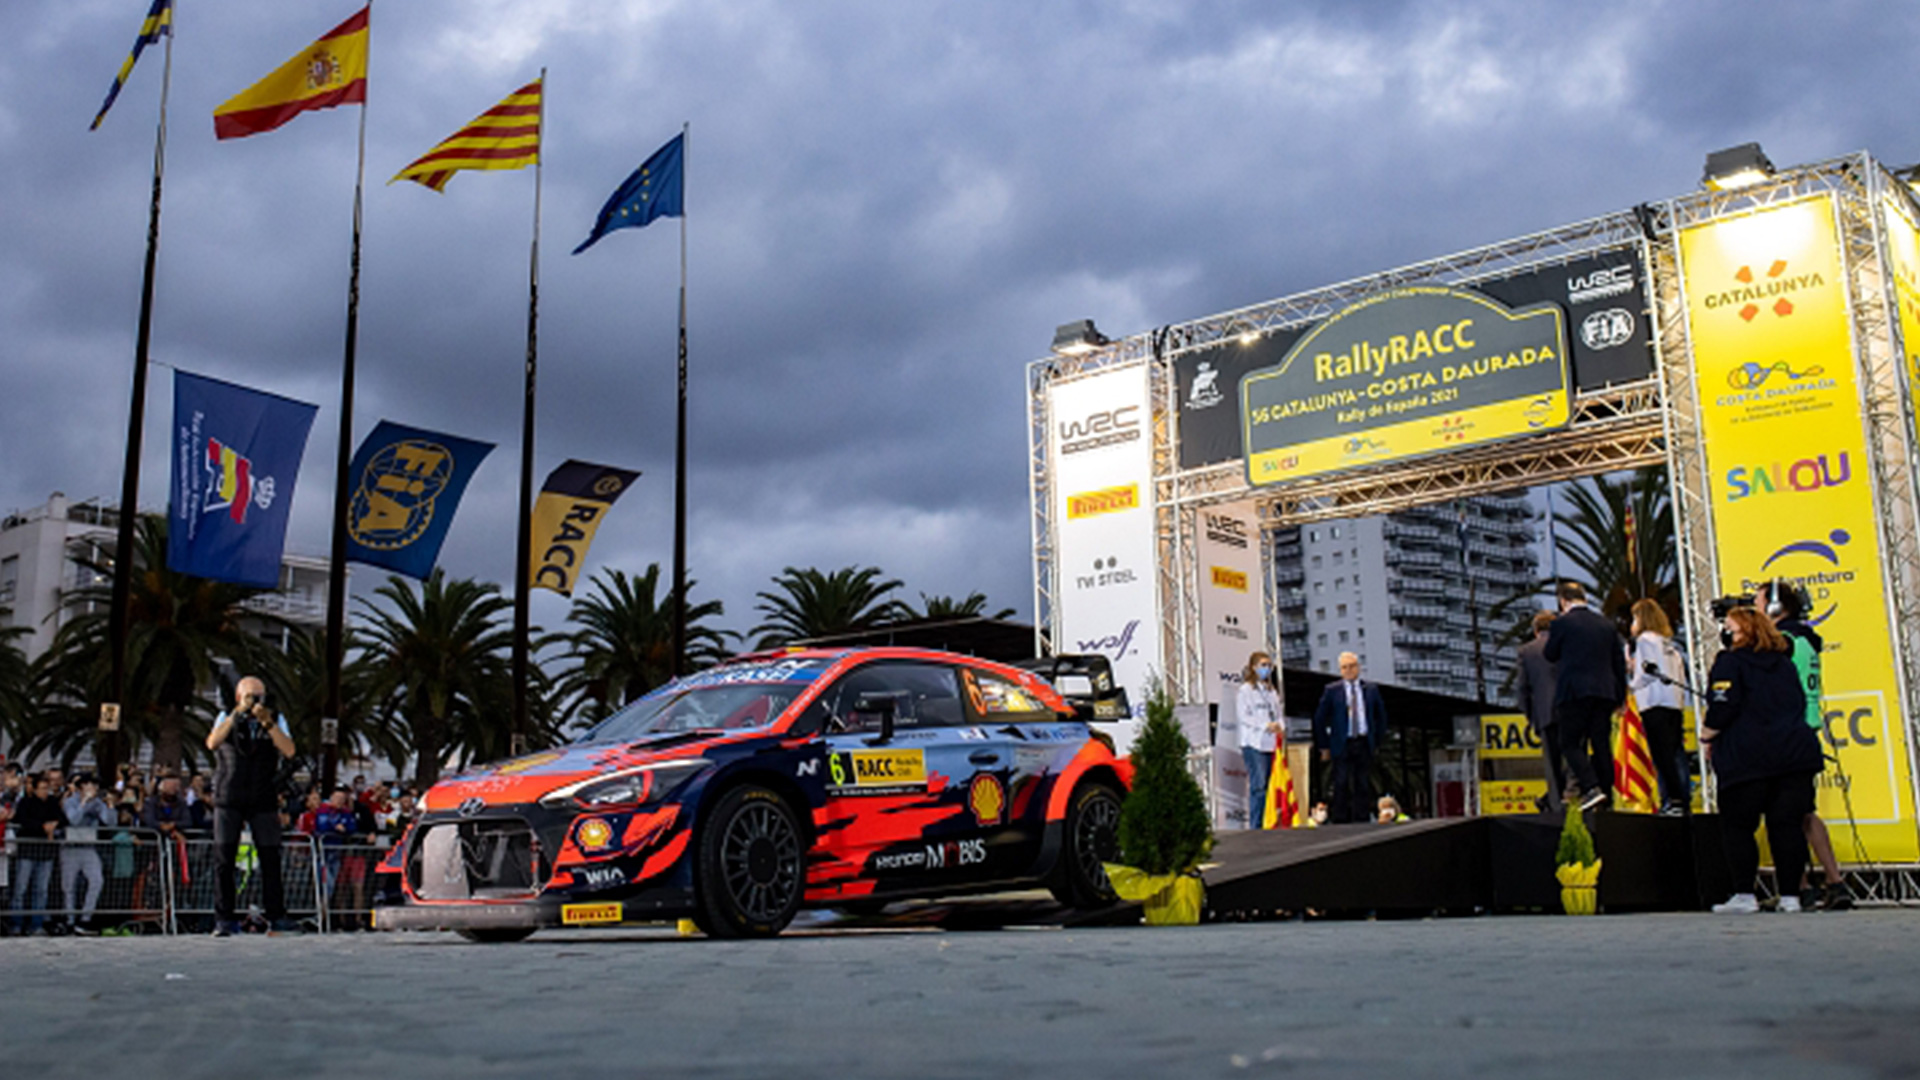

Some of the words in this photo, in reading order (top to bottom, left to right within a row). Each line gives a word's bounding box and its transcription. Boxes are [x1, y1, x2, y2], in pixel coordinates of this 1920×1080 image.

[1704, 273, 1826, 309] CATALUNYA
[1313, 320, 1475, 382] RallyRACC
[1251, 408, 1269, 426] 56
[1442, 345, 1556, 384] DAURADA
[1060, 405, 1140, 440] WRC
[1337, 407, 1366, 423] Rally
[1372, 403, 1384, 416] de
[1431, 387, 1459, 404] 2021
[358, 442, 448, 531] FIA
[1726, 451, 1852, 501] SALOU
[536, 503, 602, 593] RACC
[1484, 720, 1543, 751] RAC
[1823, 708, 1877, 748] CC
[829, 752, 847, 787] 6
[856, 759, 895, 777] RACC
[925, 838, 987, 869] MOBIS
